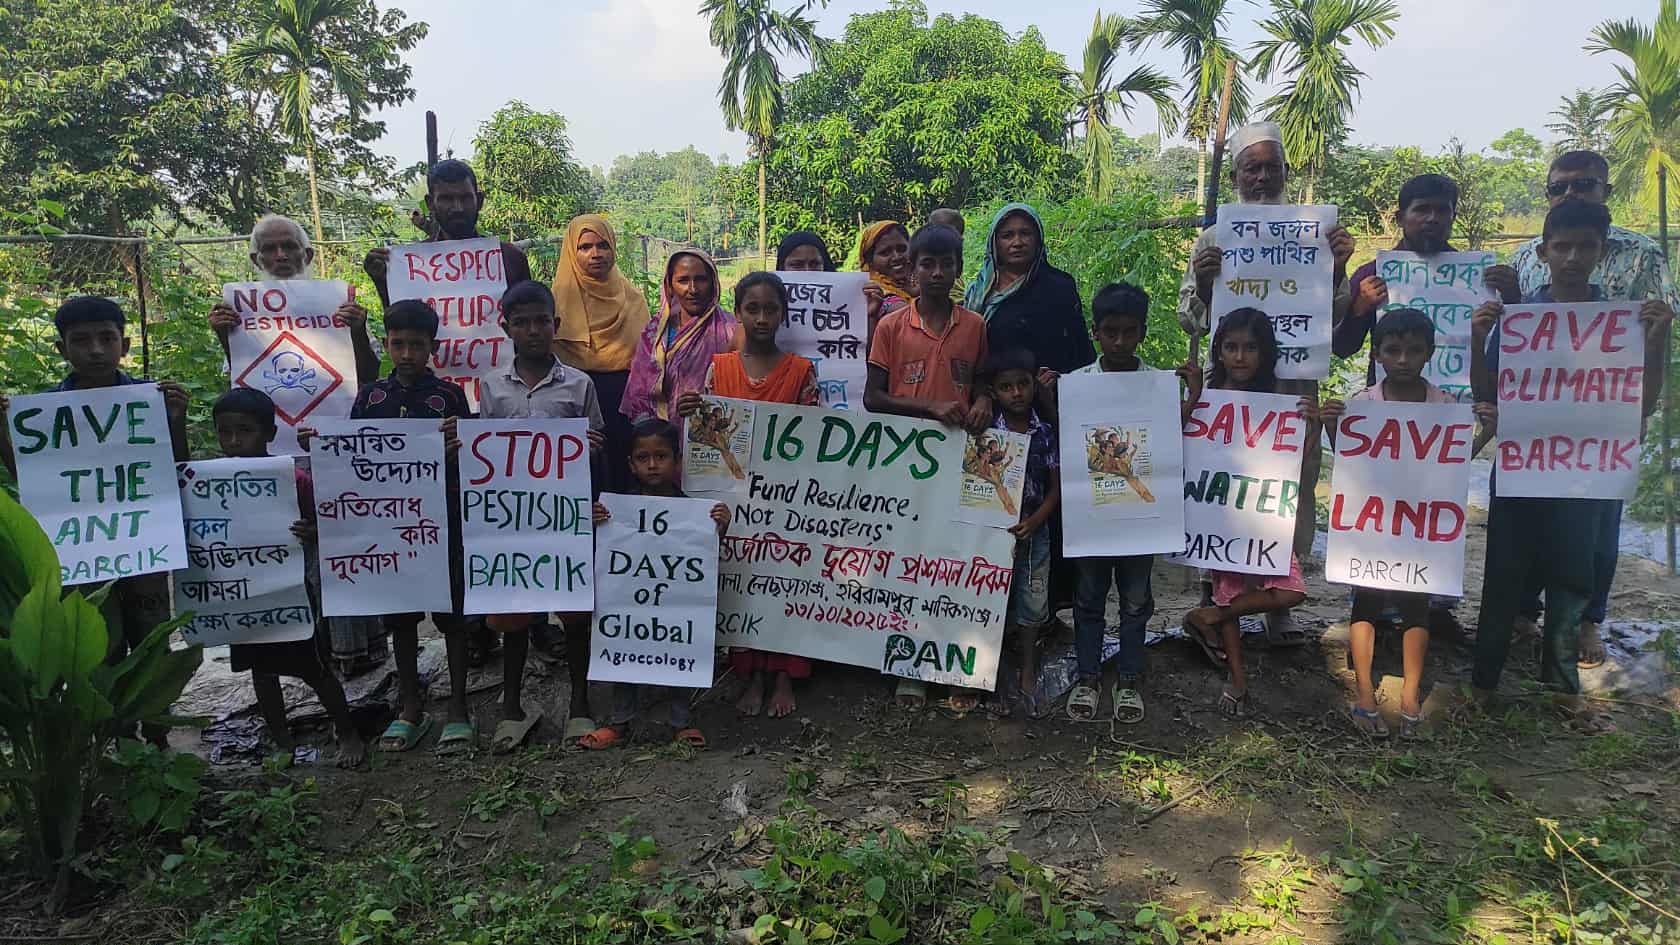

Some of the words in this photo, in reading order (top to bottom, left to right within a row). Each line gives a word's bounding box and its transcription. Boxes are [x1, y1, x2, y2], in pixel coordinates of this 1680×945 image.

[1232, 221, 1260, 239] বন
[234, 289, 287, 312] NO
[1280, 280, 1298, 295] ও
[240, 315, 347, 331] ESTICIDE
[1500, 309, 1633, 353] SAVE
[432, 337, 505, 369] JECT
[816, 334, 862, 359] করি
[1499, 366, 1644, 402] CLIMATE
[13, 401, 156, 454] SAVE
[1339, 415, 1473, 464] SAVE
[469, 430, 584, 486] STOP
[763, 414, 804, 461] 16
[817, 416, 946, 480] DAYS
[1498, 435, 1637, 472] BARCIK
[59, 461, 153, 503] THE
[463, 489, 592, 536] PESTISIDE
[637, 508, 670, 536] 16
[735, 504, 775, 527] Not
[1331, 494, 1465, 542] LAND
[392, 519, 440, 545] করি
[469, 552, 587, 592] BARCIK
[608, 550, 705, 582] DAYS
[1350, 558, 1428, 585] BARCIK
[182, 577, 252, 602] আমরা
[634, 583, 669, 606] of
[599, 613, 693, 645] Global
[884, 634, 976, 676] PAN
